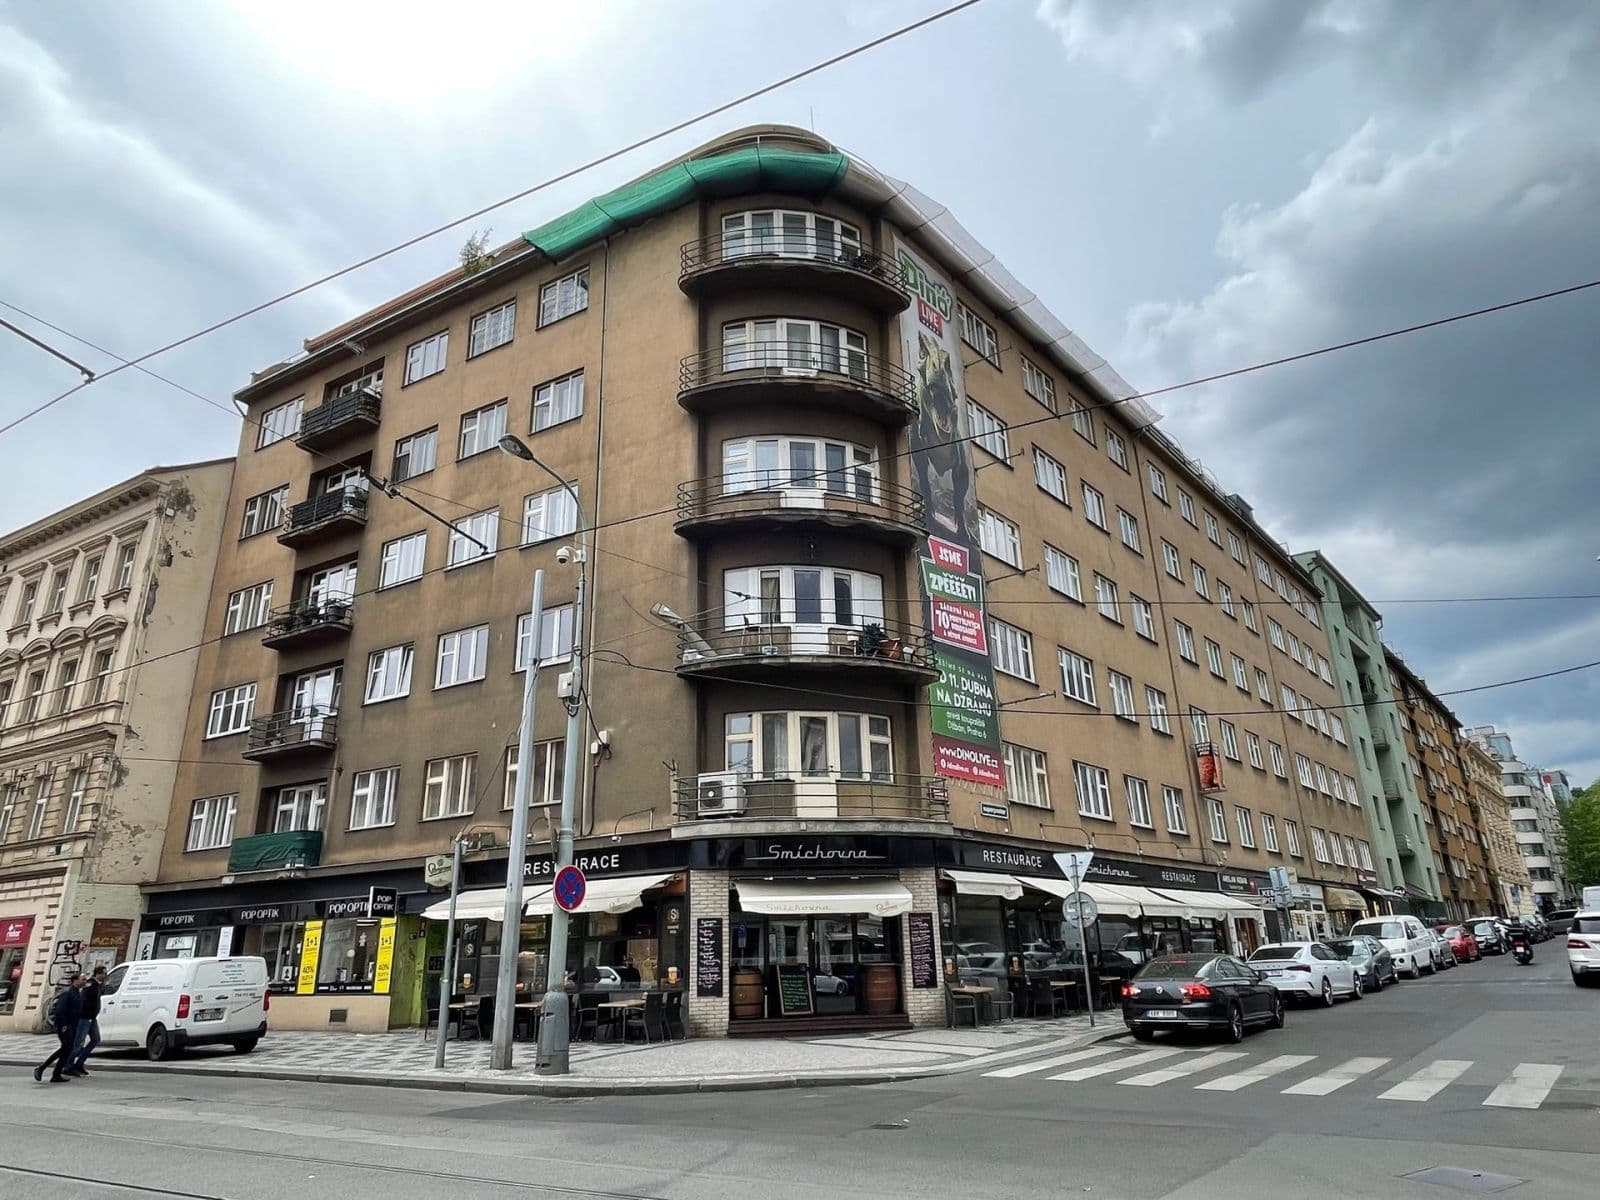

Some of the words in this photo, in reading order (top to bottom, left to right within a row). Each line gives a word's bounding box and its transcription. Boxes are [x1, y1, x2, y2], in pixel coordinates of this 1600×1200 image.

[921, 303, 941, 328] LIVE
[938, 547, 963, 566] JSME
[935, 609, 950, 630] 70
[961, 676, 994, 701] DUBNA
[936, 688, 951, 705] NA
[982, 849, 1043, 868] RESTAURACE
[1161, 871, 1197, 884] RESTAURACE
[376, 895, 391, 903] POP
[328, 903, 346, 914] POP
[373, 903, 394, 911] OPTIK
[160, 916, 174, 926] POP
[174, 914, 196, 925] OPTIK
[240, 910, 256, 920] POP
[257, 908, 280, 920] OPTIK
[306, 936, 318, 947] 1+1
[381, 936, 392, 946] 1+1
